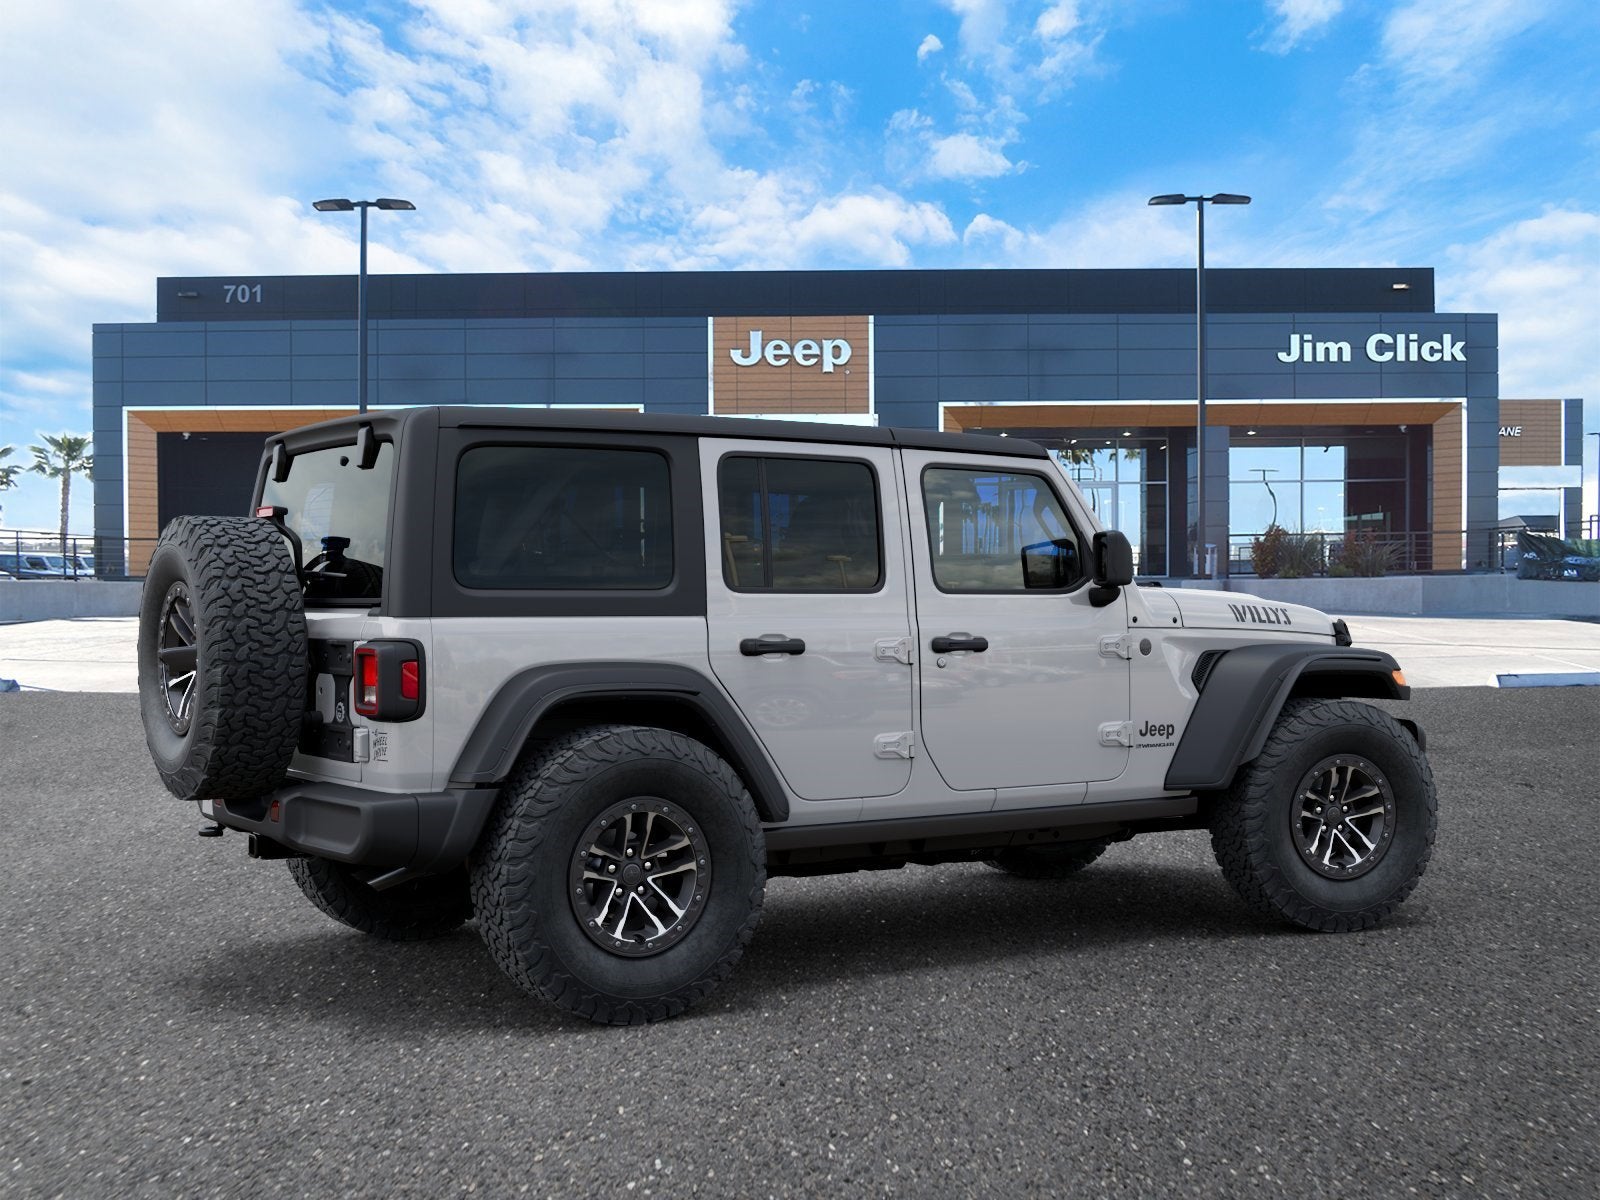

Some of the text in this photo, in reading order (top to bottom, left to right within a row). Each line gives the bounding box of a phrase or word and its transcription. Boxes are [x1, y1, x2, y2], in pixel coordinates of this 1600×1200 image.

[223, 284, 262, 303] 701
[729, 330, 852, 373] Jeep
[1277, 333, 1467, 363] Jim Click
[1498, 426, 1522, 437] ANE
[1228, 603, 1291, 626] WILLYS
[1139, 720, 1175, 739] Jeep
